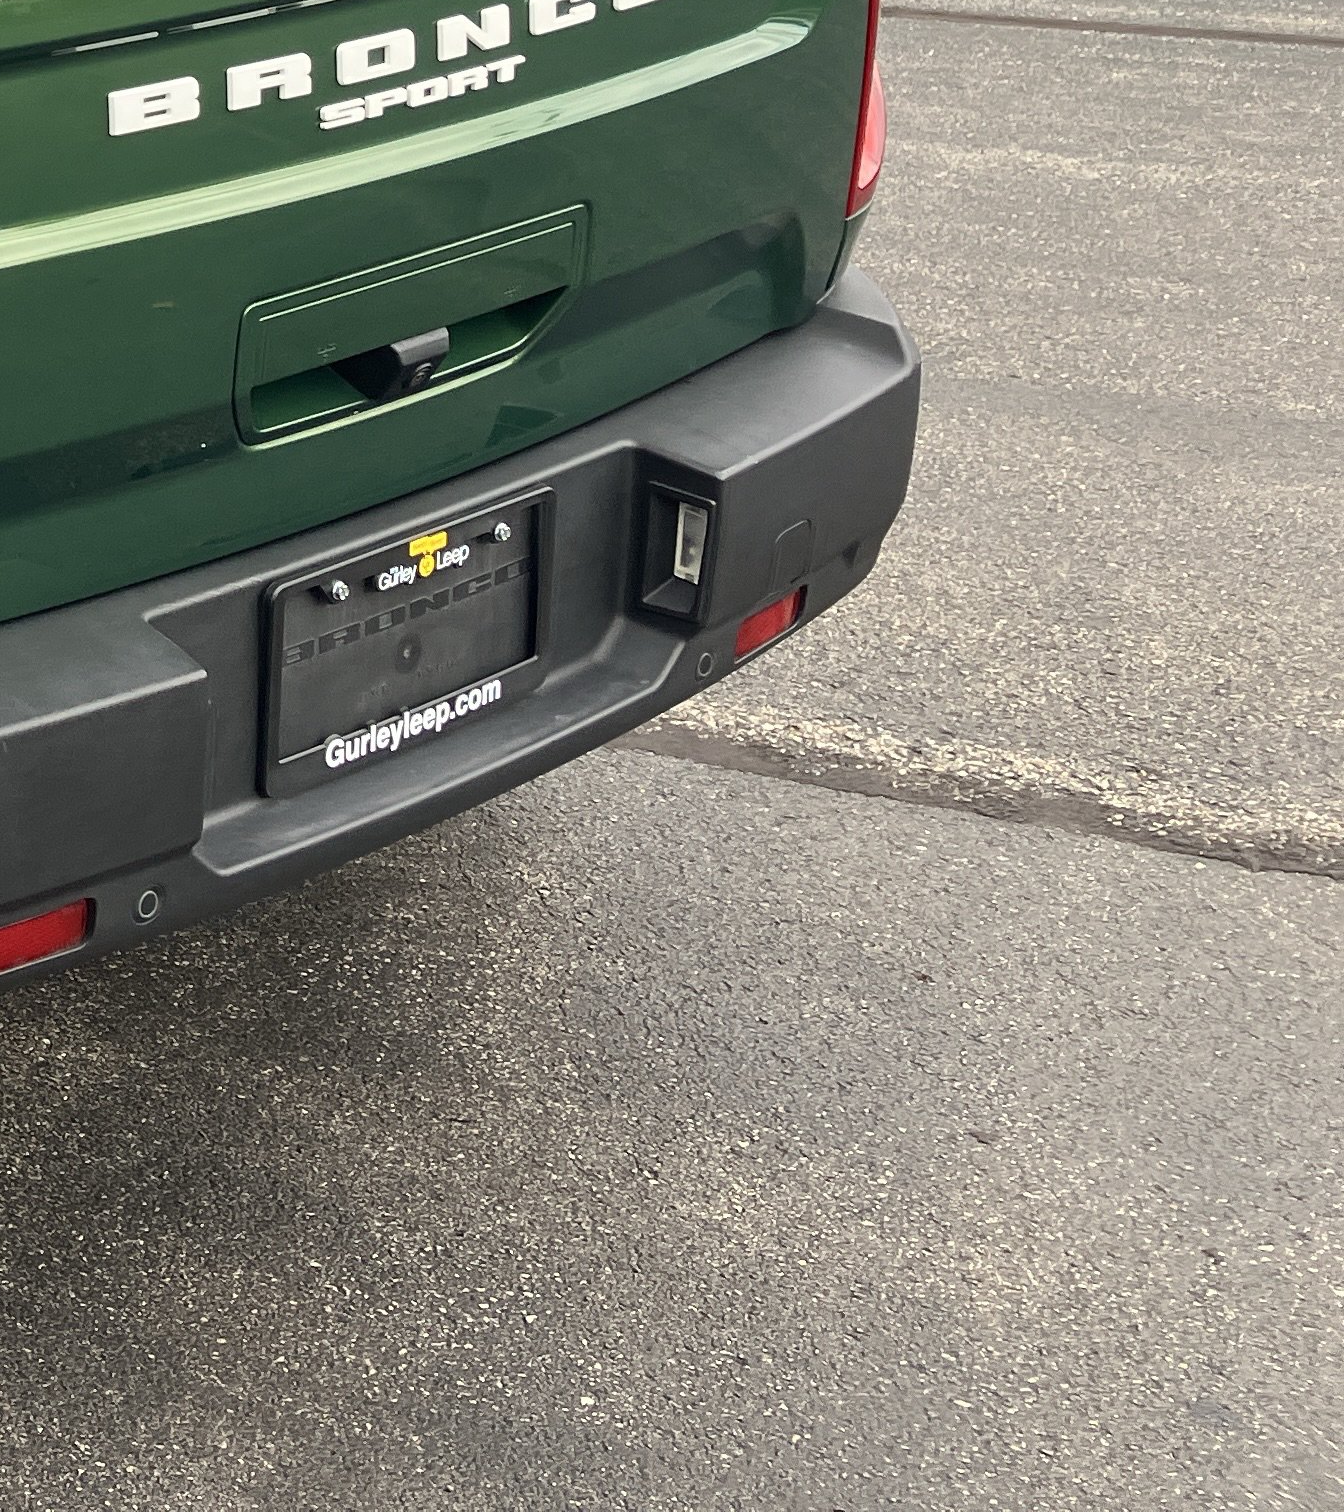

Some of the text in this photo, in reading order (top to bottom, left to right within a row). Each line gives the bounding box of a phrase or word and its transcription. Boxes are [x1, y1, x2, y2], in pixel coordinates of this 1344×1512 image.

[319, 55, 526, 130] SPORT
[378, 565, 418, 591] Gurley
[437, 544, 470, 570] Leep
[324, 679, 502, 768] Gurleyleep.com
